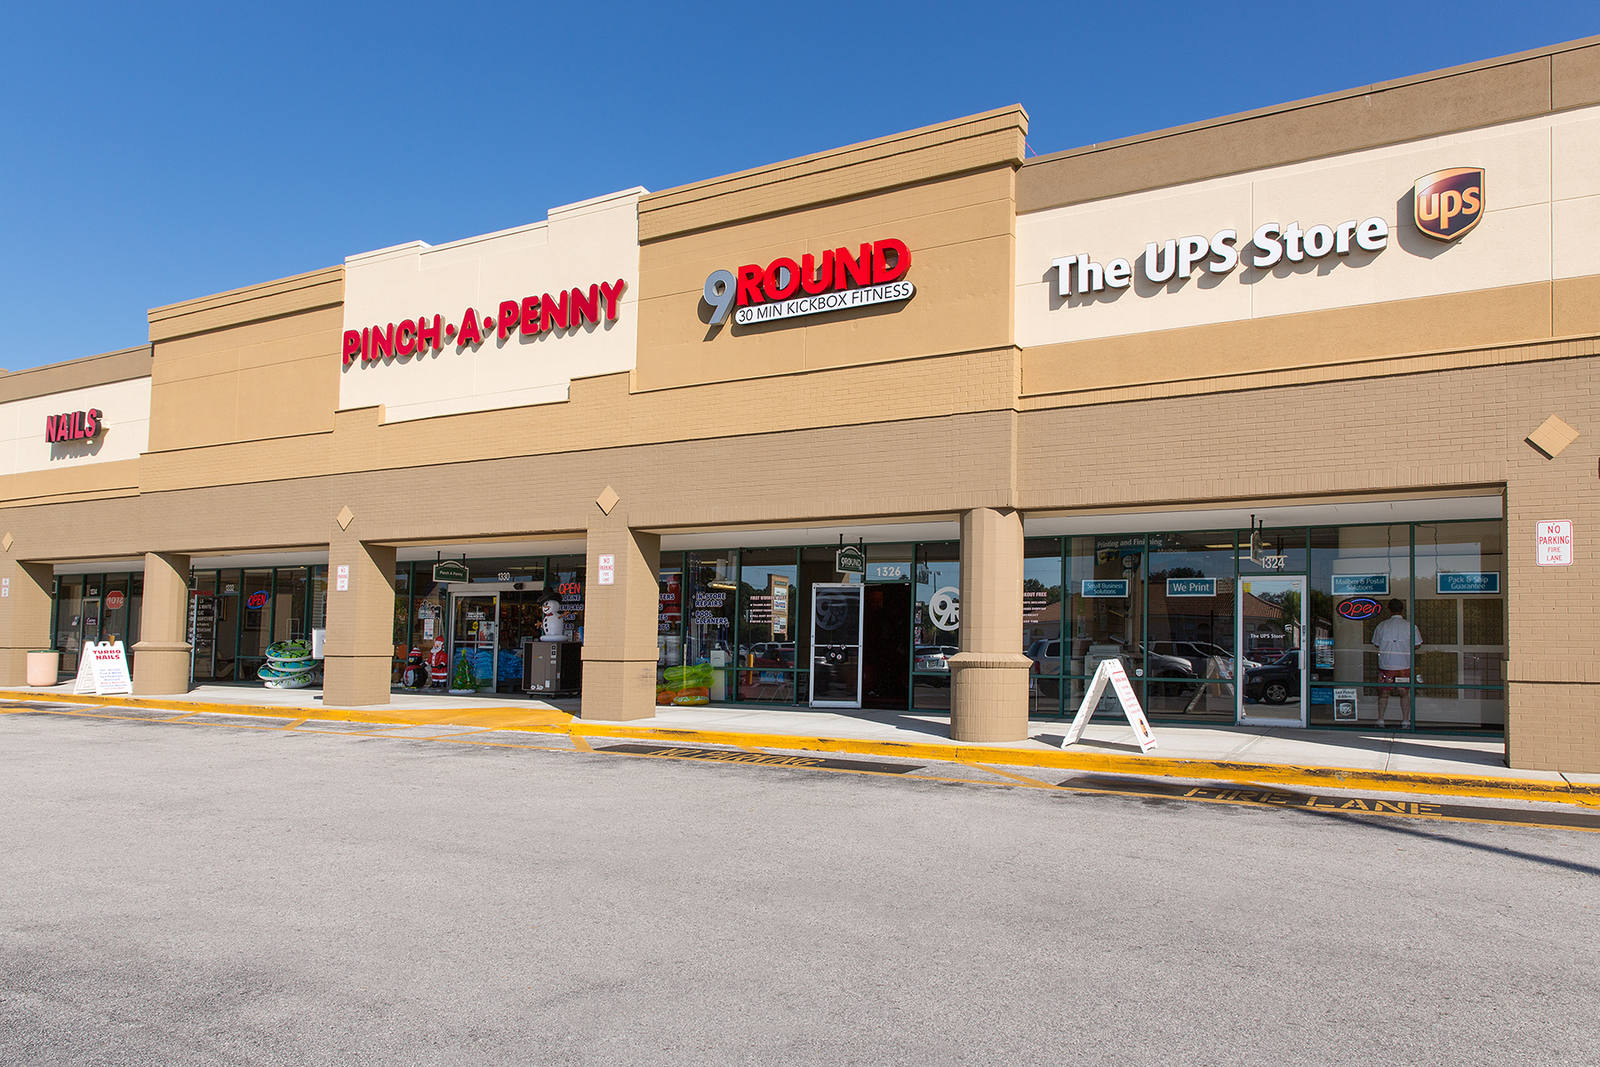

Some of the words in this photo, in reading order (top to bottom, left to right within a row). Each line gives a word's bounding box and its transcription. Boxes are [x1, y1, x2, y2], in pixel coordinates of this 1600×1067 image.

[1419, 186, 1480, 229] ups
[1052, 253, 1131, 296] The
[1145, 229, 1238, 283] UPS
[1253, 216, 1389, 268] Store
[738, 309, 753, 323] 30
[757, 304, 783, 320] MIN
[787, 293, 847, 315] KICKBOX
[851, 282, 910, 304] FITNESS
[45, 408, 103, 443] NAILS
[1547, 525, 1561, 534] NO
[1539, 535, 1569, 544] PARKING
[1262, 557, 1285, 568] 1324
[497, 572, 511, 581] 1330
[877, 566, 901, 576] 1326
[1172, 582, 1187, 592] We
[1189, 581, 1210, 592] Print
[1366, 577, 1385, 585] Postal
[559, 582, 581, 595] OPEN
[249, 593, 267, 607] OPEN
[695, 600, 723, 608] REPAIRS
[1339, 601, 1382, 617] Open
[695, 617, 729, 625] CLEANERS
[1183, 786, 1288, 805] FIRE
[1305, 795, 1444, 817] LANE
